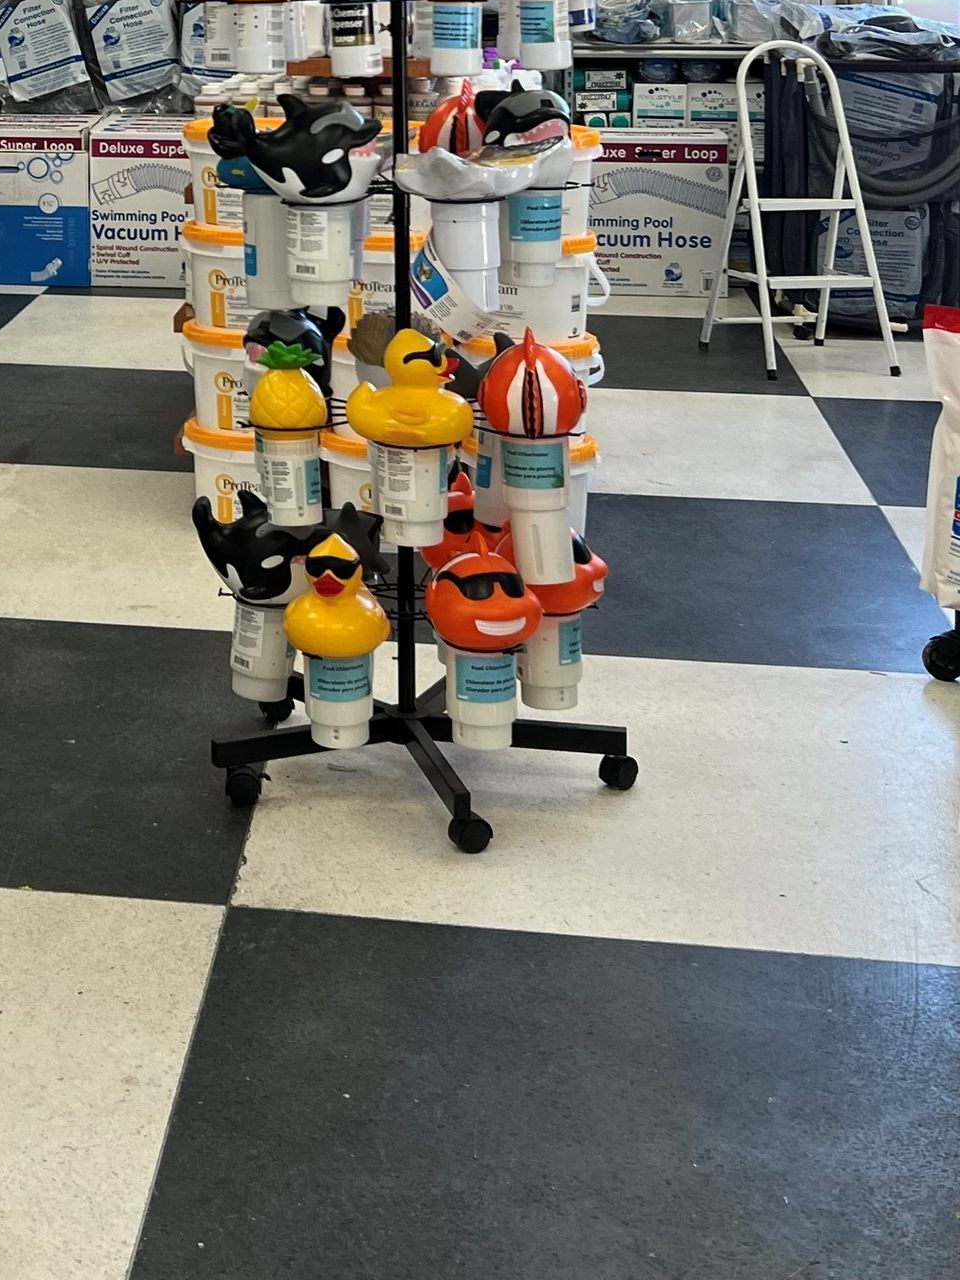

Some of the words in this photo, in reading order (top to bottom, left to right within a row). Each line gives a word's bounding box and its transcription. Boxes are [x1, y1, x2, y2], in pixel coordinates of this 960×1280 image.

[22, 4, 42, 15] Filter
[90, 4, 109, 25] Deluxe
[119, 4, 139, 14] Filter
[13, 7, 55, 26] Connection
[26, 18, 47, 29] Hose
[109, 9, 153, 25] Connection
[123, 19, 143, 29] Hose
[0, 139, 37, 150] Super
[43, 140, 74, 150] Loop
[99, 142, 144, 154] Deluxe
[684, 147, 718, 161] Loop
[217, 191, 241, 199] Alkalinity
[91, 209, 157, 224] Swimming
[589, 216, 639, 230] imming
[644, 216, 673, 228] Pool
[92, 224, 168, 241] Vacuum
[597, 233, 651, 248] cuum
[658, 232, 712, 248] Hose
